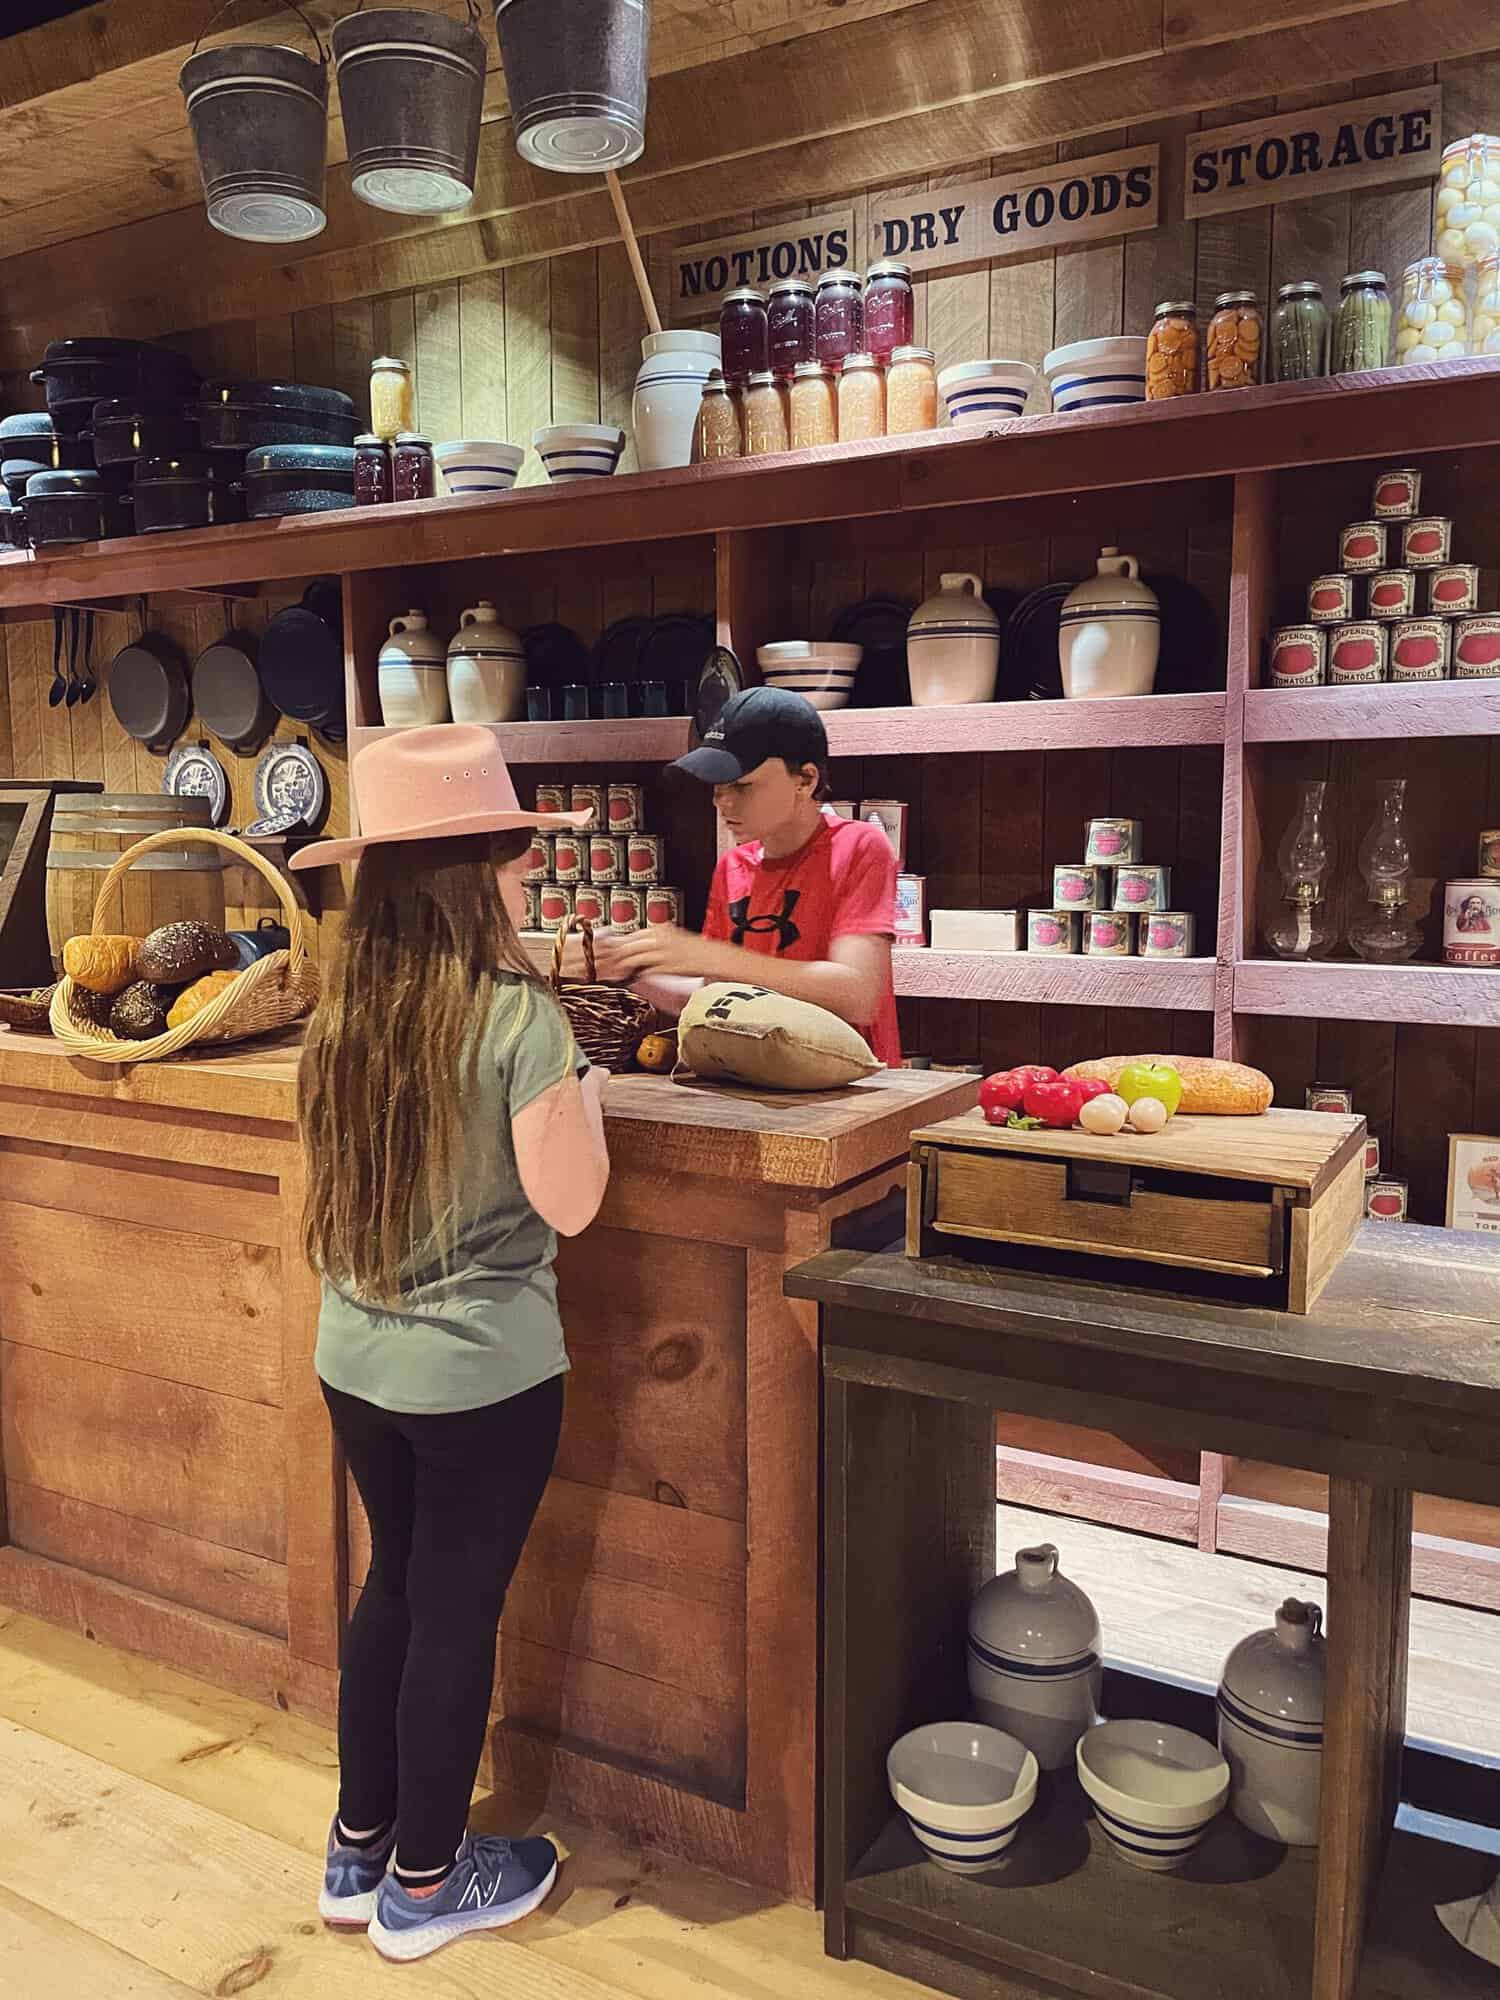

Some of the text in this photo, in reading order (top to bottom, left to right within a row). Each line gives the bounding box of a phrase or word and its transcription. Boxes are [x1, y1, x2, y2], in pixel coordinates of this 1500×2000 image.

[1191, 108, 1432, 194] STORAGE
[882, 165, 1153, 257] DRY GOODS
[679, 228, 849, 298] NOTIONS
[1336, 627, 1378, 641] DEFENDER
[1396, 623, 1440, 637] DEFENDER
[1461, 620, 1500, 634] DEFENDE
[1275, 631, 1317, 645] DEFENDER
[1273, 675, 1315, 686] TOMATOES
[1334, 671, 1376, 681] TOMATOES
[1394, 668, 1438, 679] TOMATOES
[1446, 950, 1497, 961] Coffee
